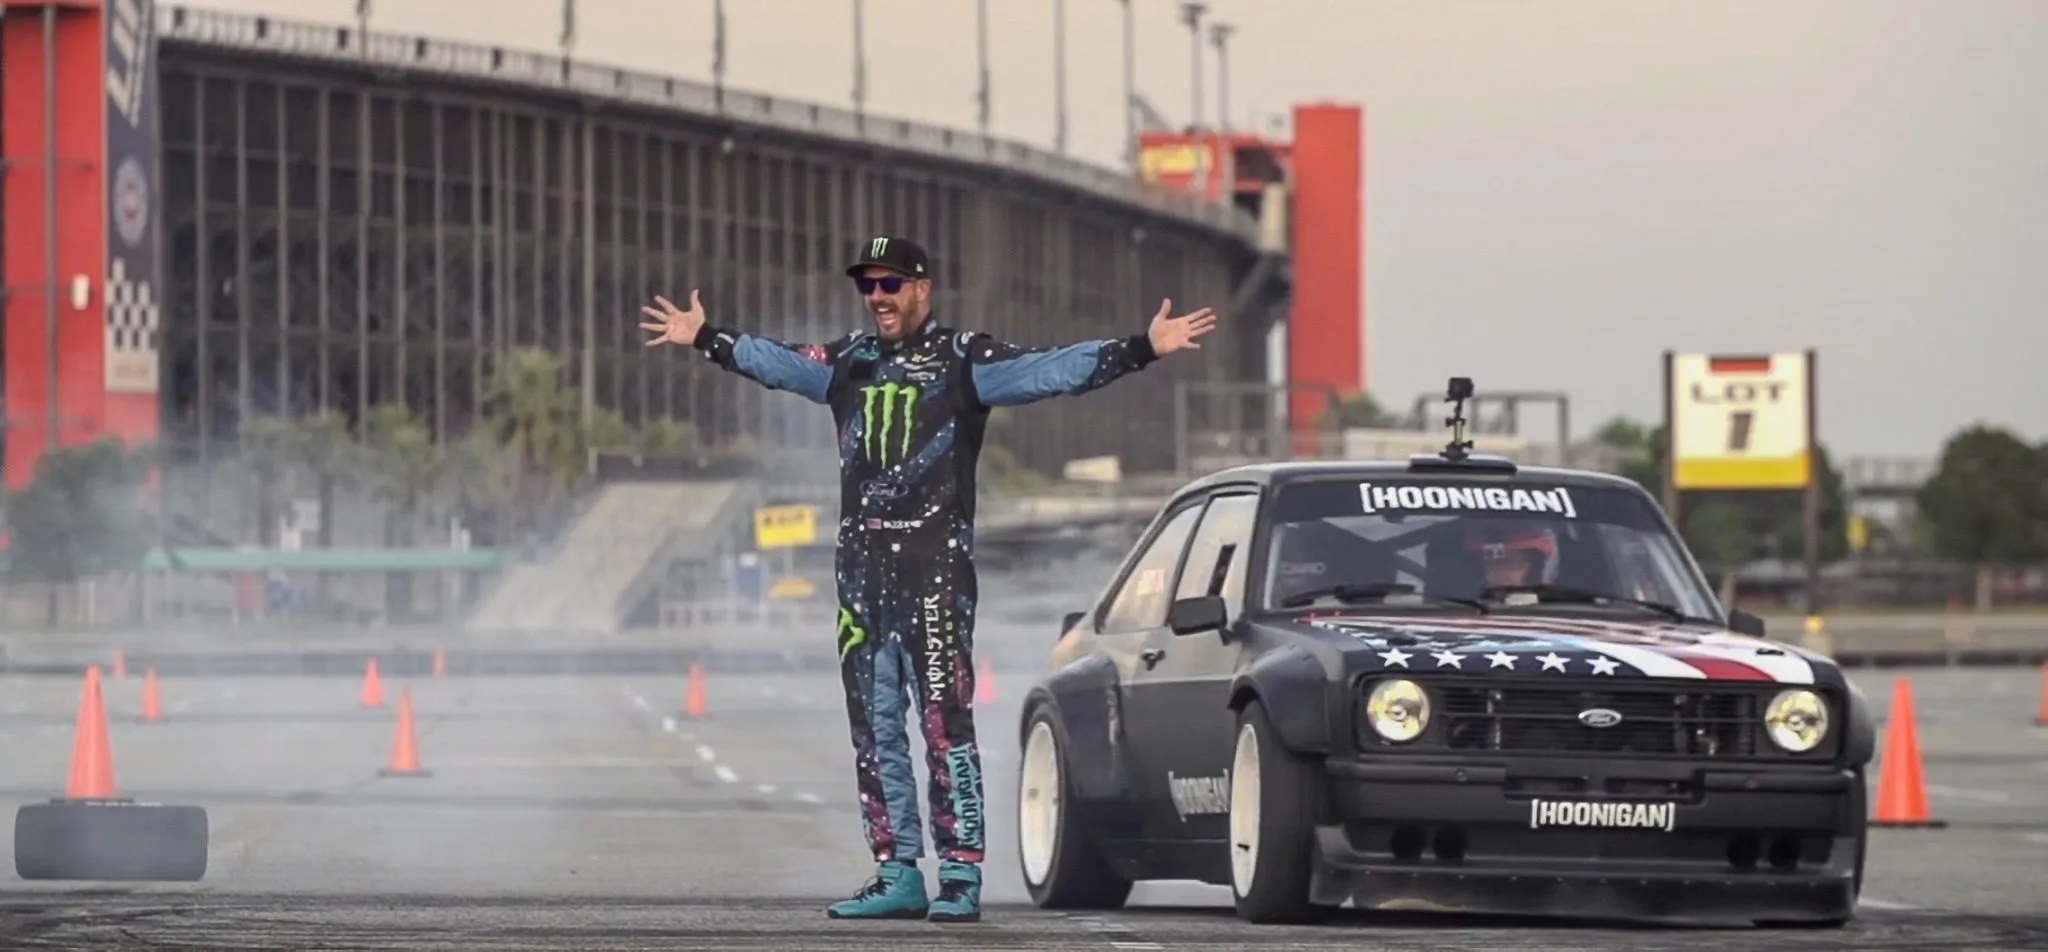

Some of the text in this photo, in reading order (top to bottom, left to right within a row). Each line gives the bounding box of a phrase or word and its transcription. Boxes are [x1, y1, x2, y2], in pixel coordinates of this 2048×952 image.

[1690, 381, 1789, 404] LOT
[1727, 411, 1753, 452] 1
[1359, 483, 1577, 518] [HOONIGAN]
[923, 593, 946, 701] MONSTER
[1531, 799, 1676, 832] [HOONIGAN]
